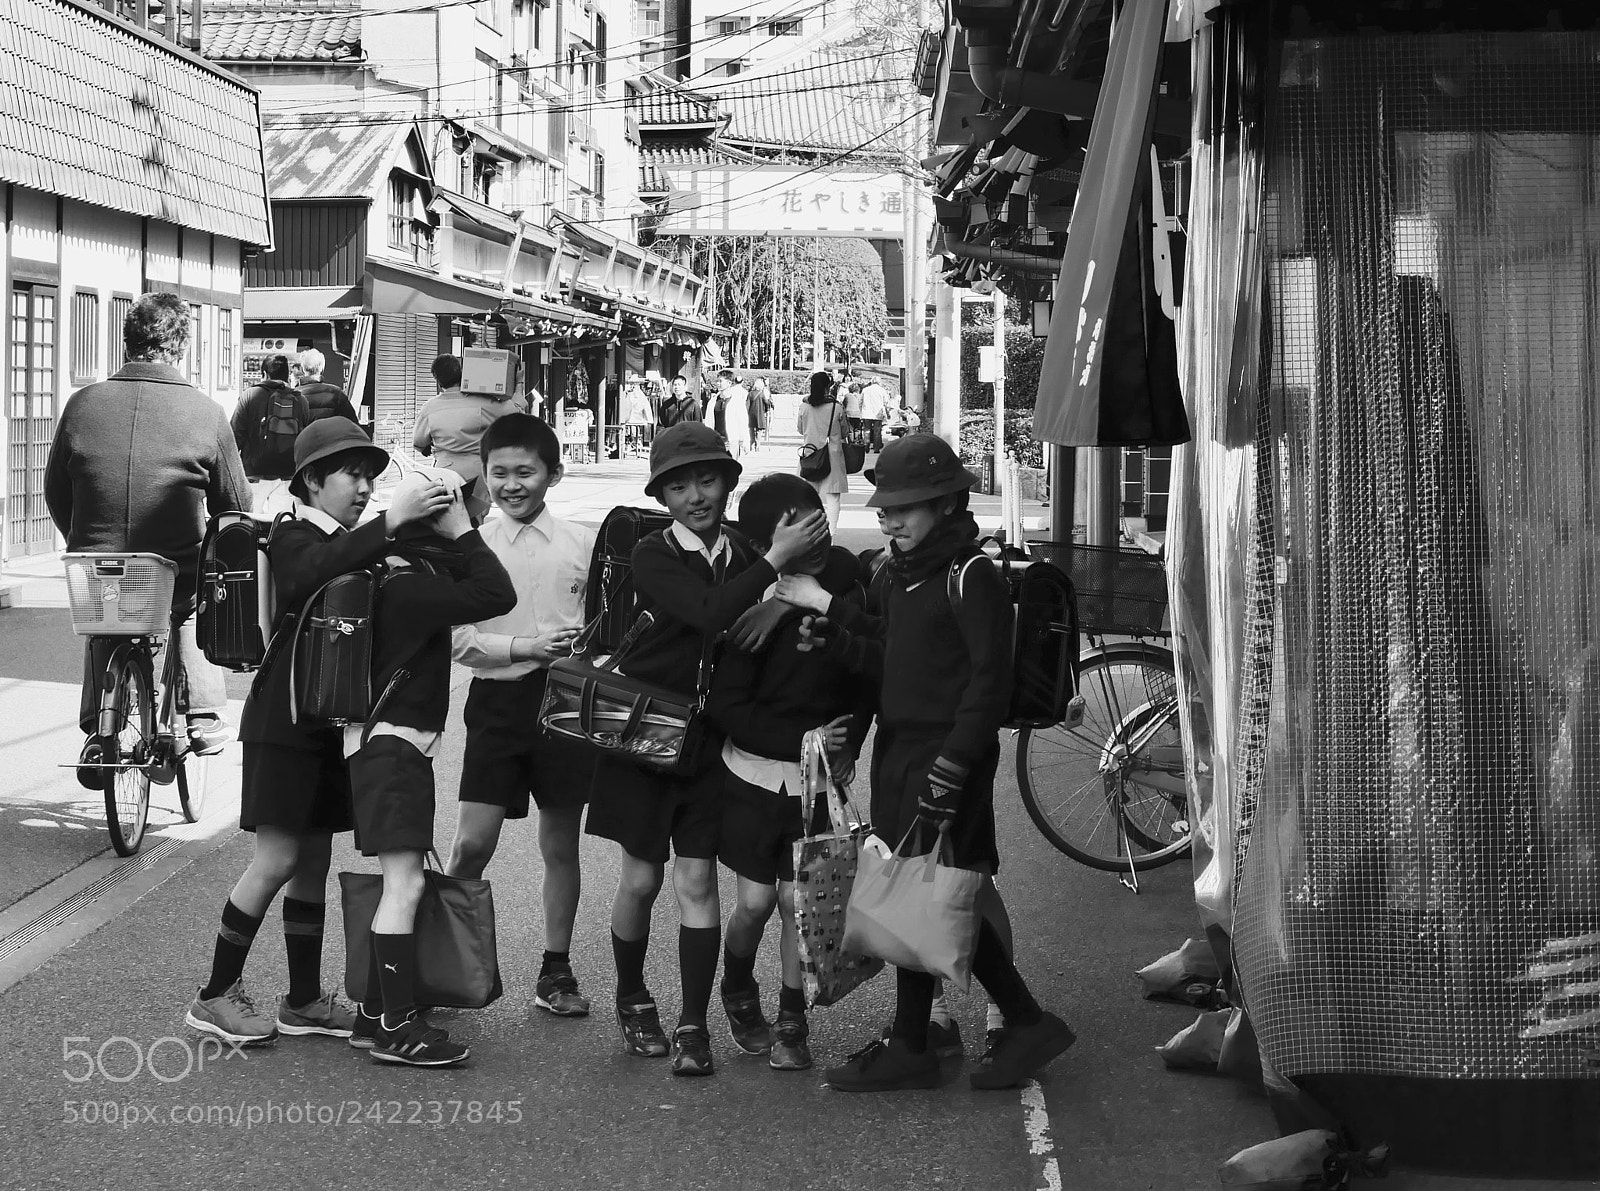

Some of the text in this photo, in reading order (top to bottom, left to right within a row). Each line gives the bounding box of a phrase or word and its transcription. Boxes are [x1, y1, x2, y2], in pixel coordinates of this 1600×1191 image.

[782, 188, 902, 215] 花やしき通
